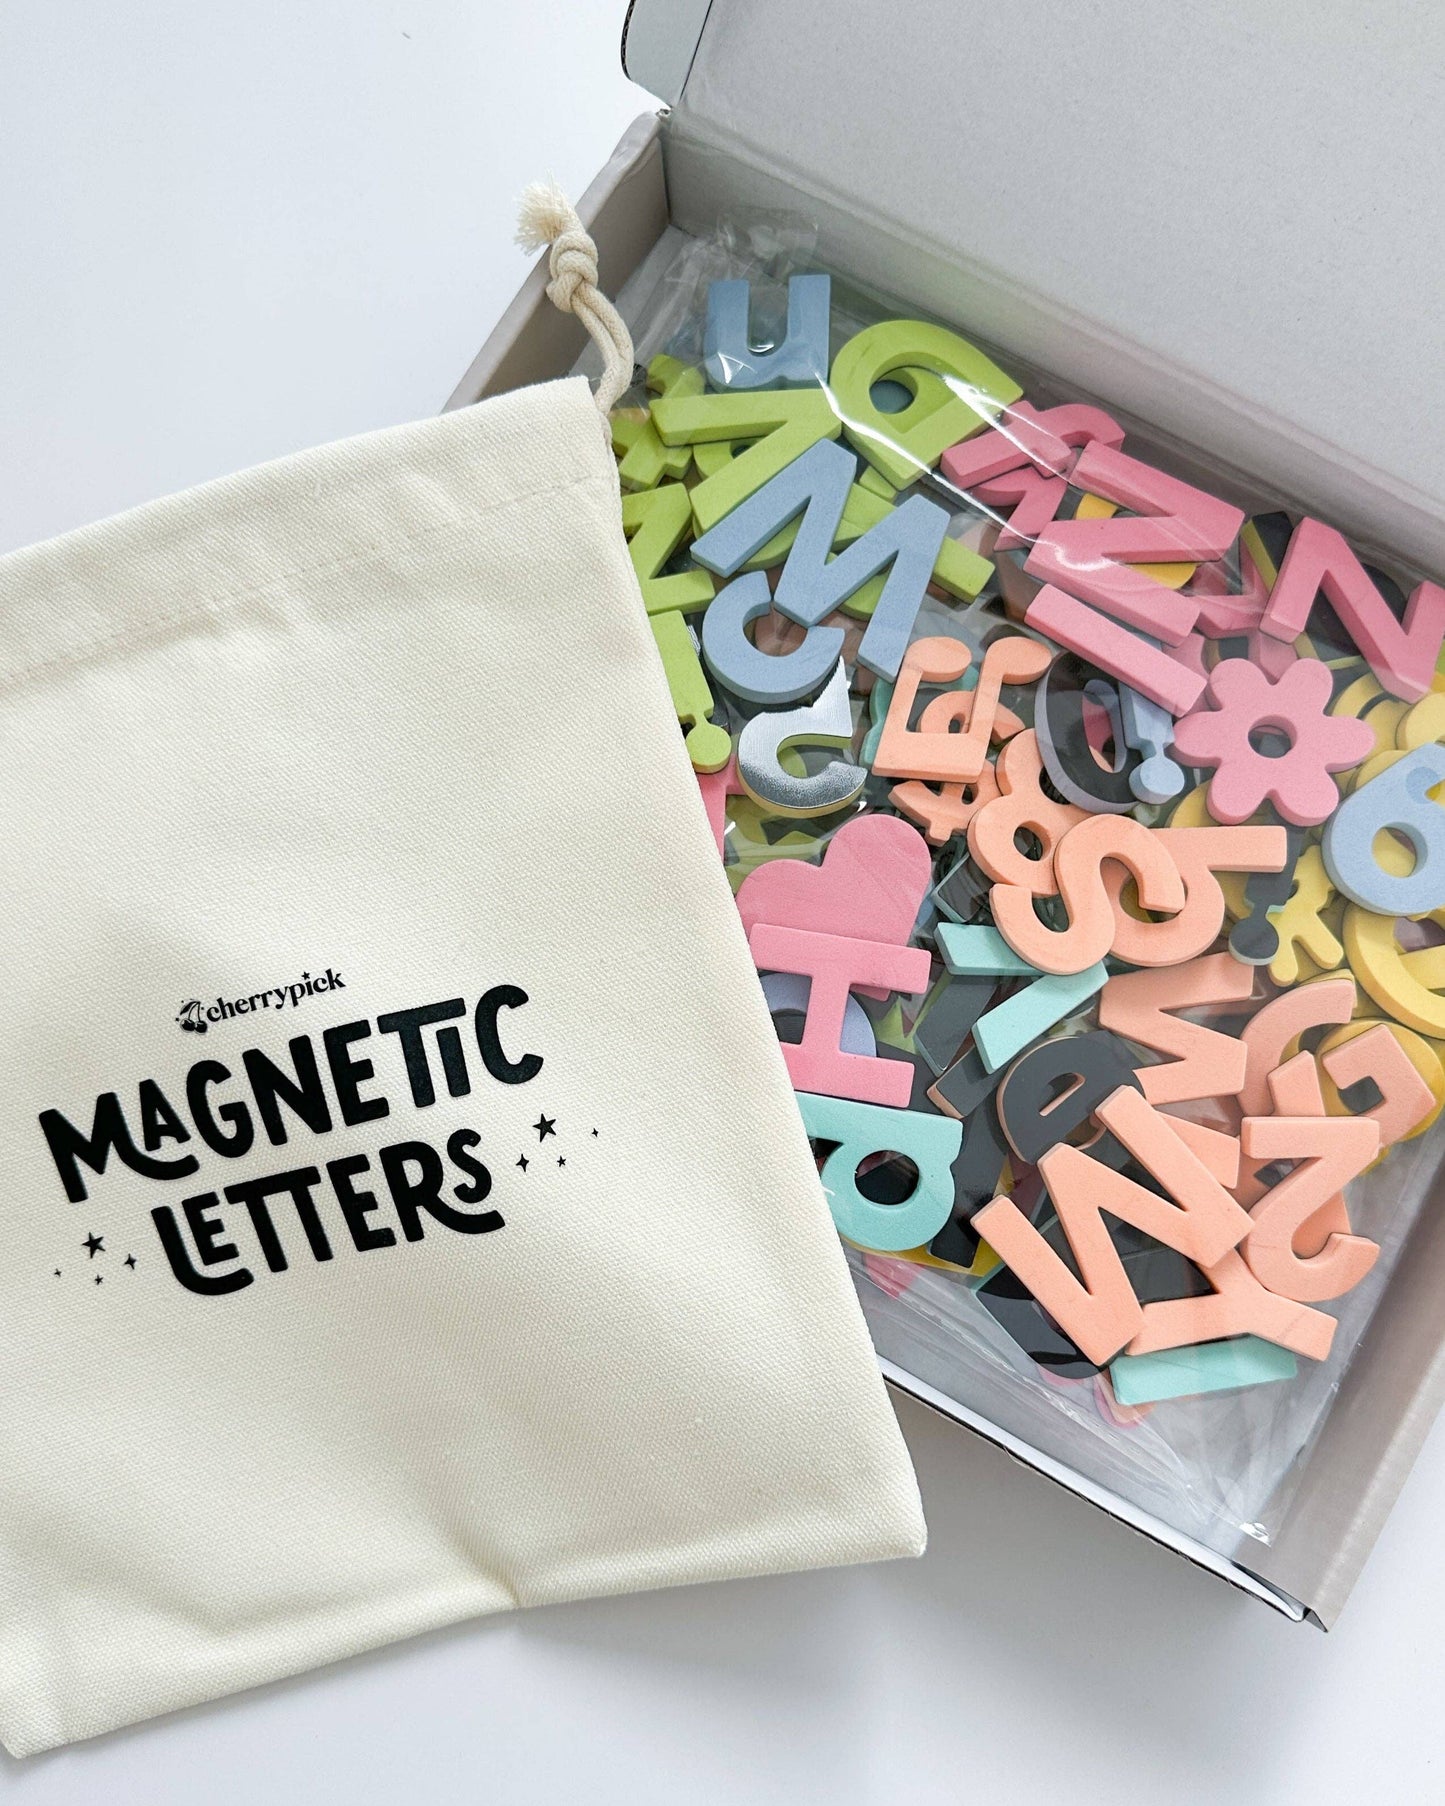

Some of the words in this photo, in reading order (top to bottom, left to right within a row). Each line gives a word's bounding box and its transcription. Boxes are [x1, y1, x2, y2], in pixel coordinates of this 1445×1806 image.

[206, 968, 346, 1024] cherrypick
[38, 984, 544, 1203] MAGNETIC
[151, 1128, 506, 1296] LETTERS
